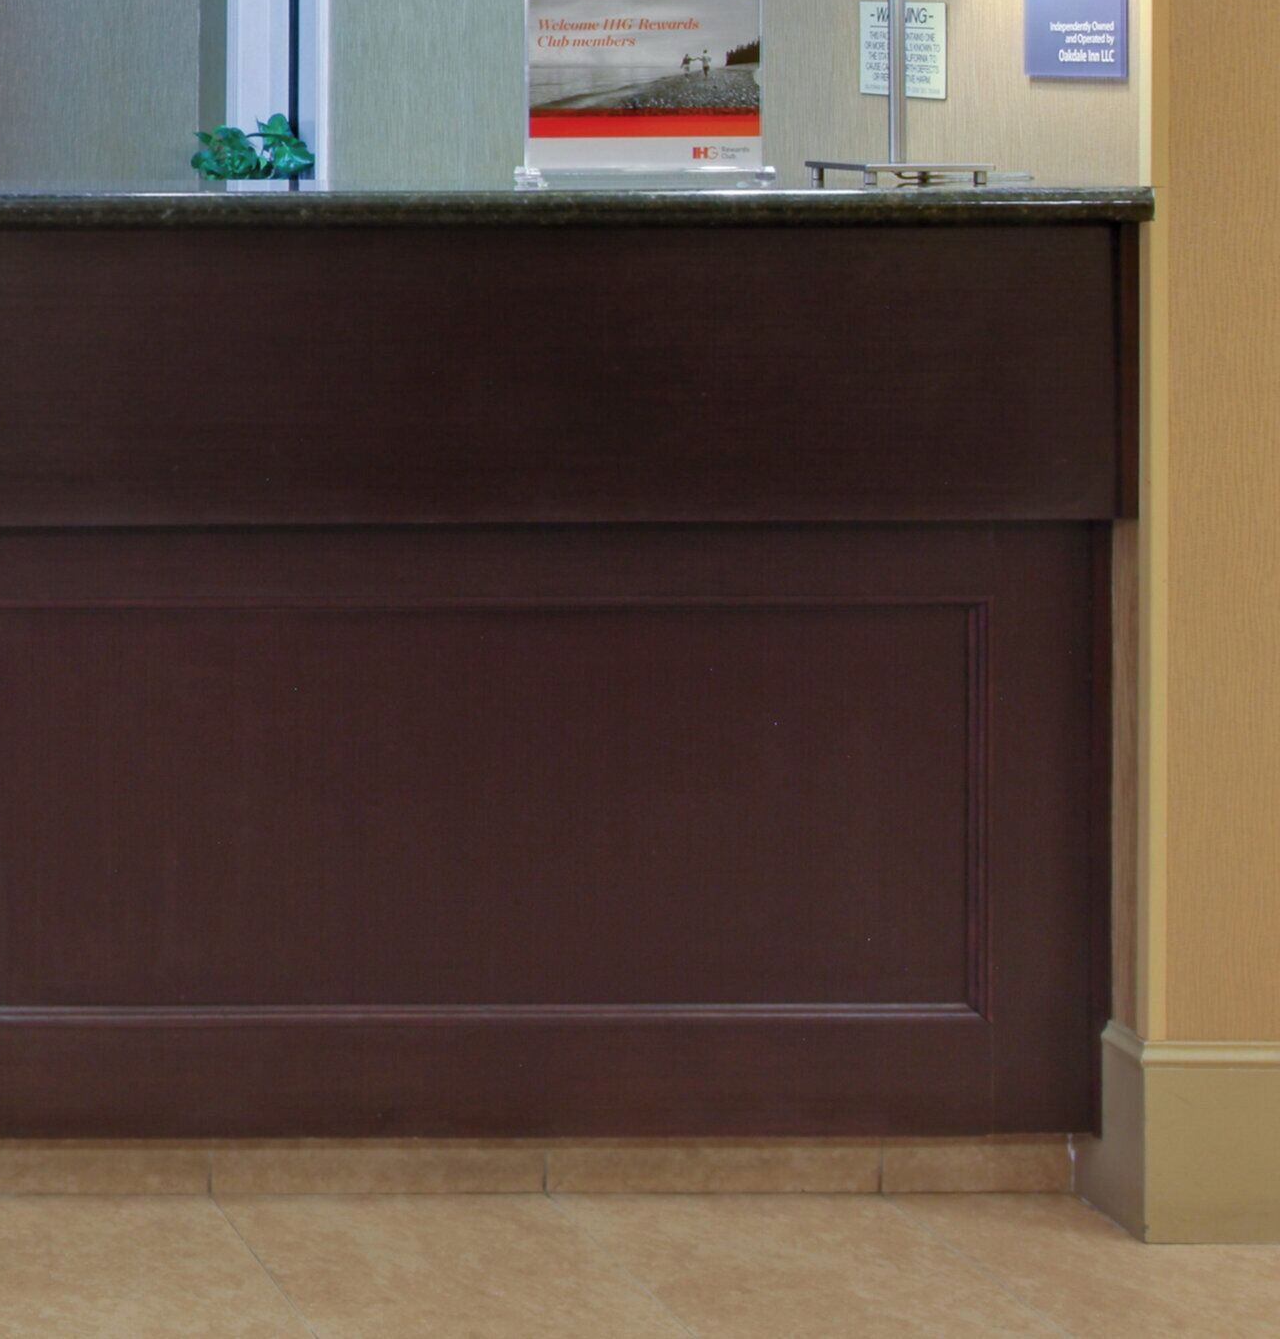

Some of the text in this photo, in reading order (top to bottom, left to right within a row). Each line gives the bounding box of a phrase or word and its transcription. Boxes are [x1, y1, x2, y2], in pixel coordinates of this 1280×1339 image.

[538, 19, 600, 31] Welcome
[638, 17, 700, 30] Rewards
[1049, 21, 1115, 33] Independently Owned
[538, 35, 636, 47] Club members
[1065, 34, 1115, 45] and Operated by
[1058, 49, 1115, 62] Oakdale Inn LLC
[692, 146, 718, 160] IHG
